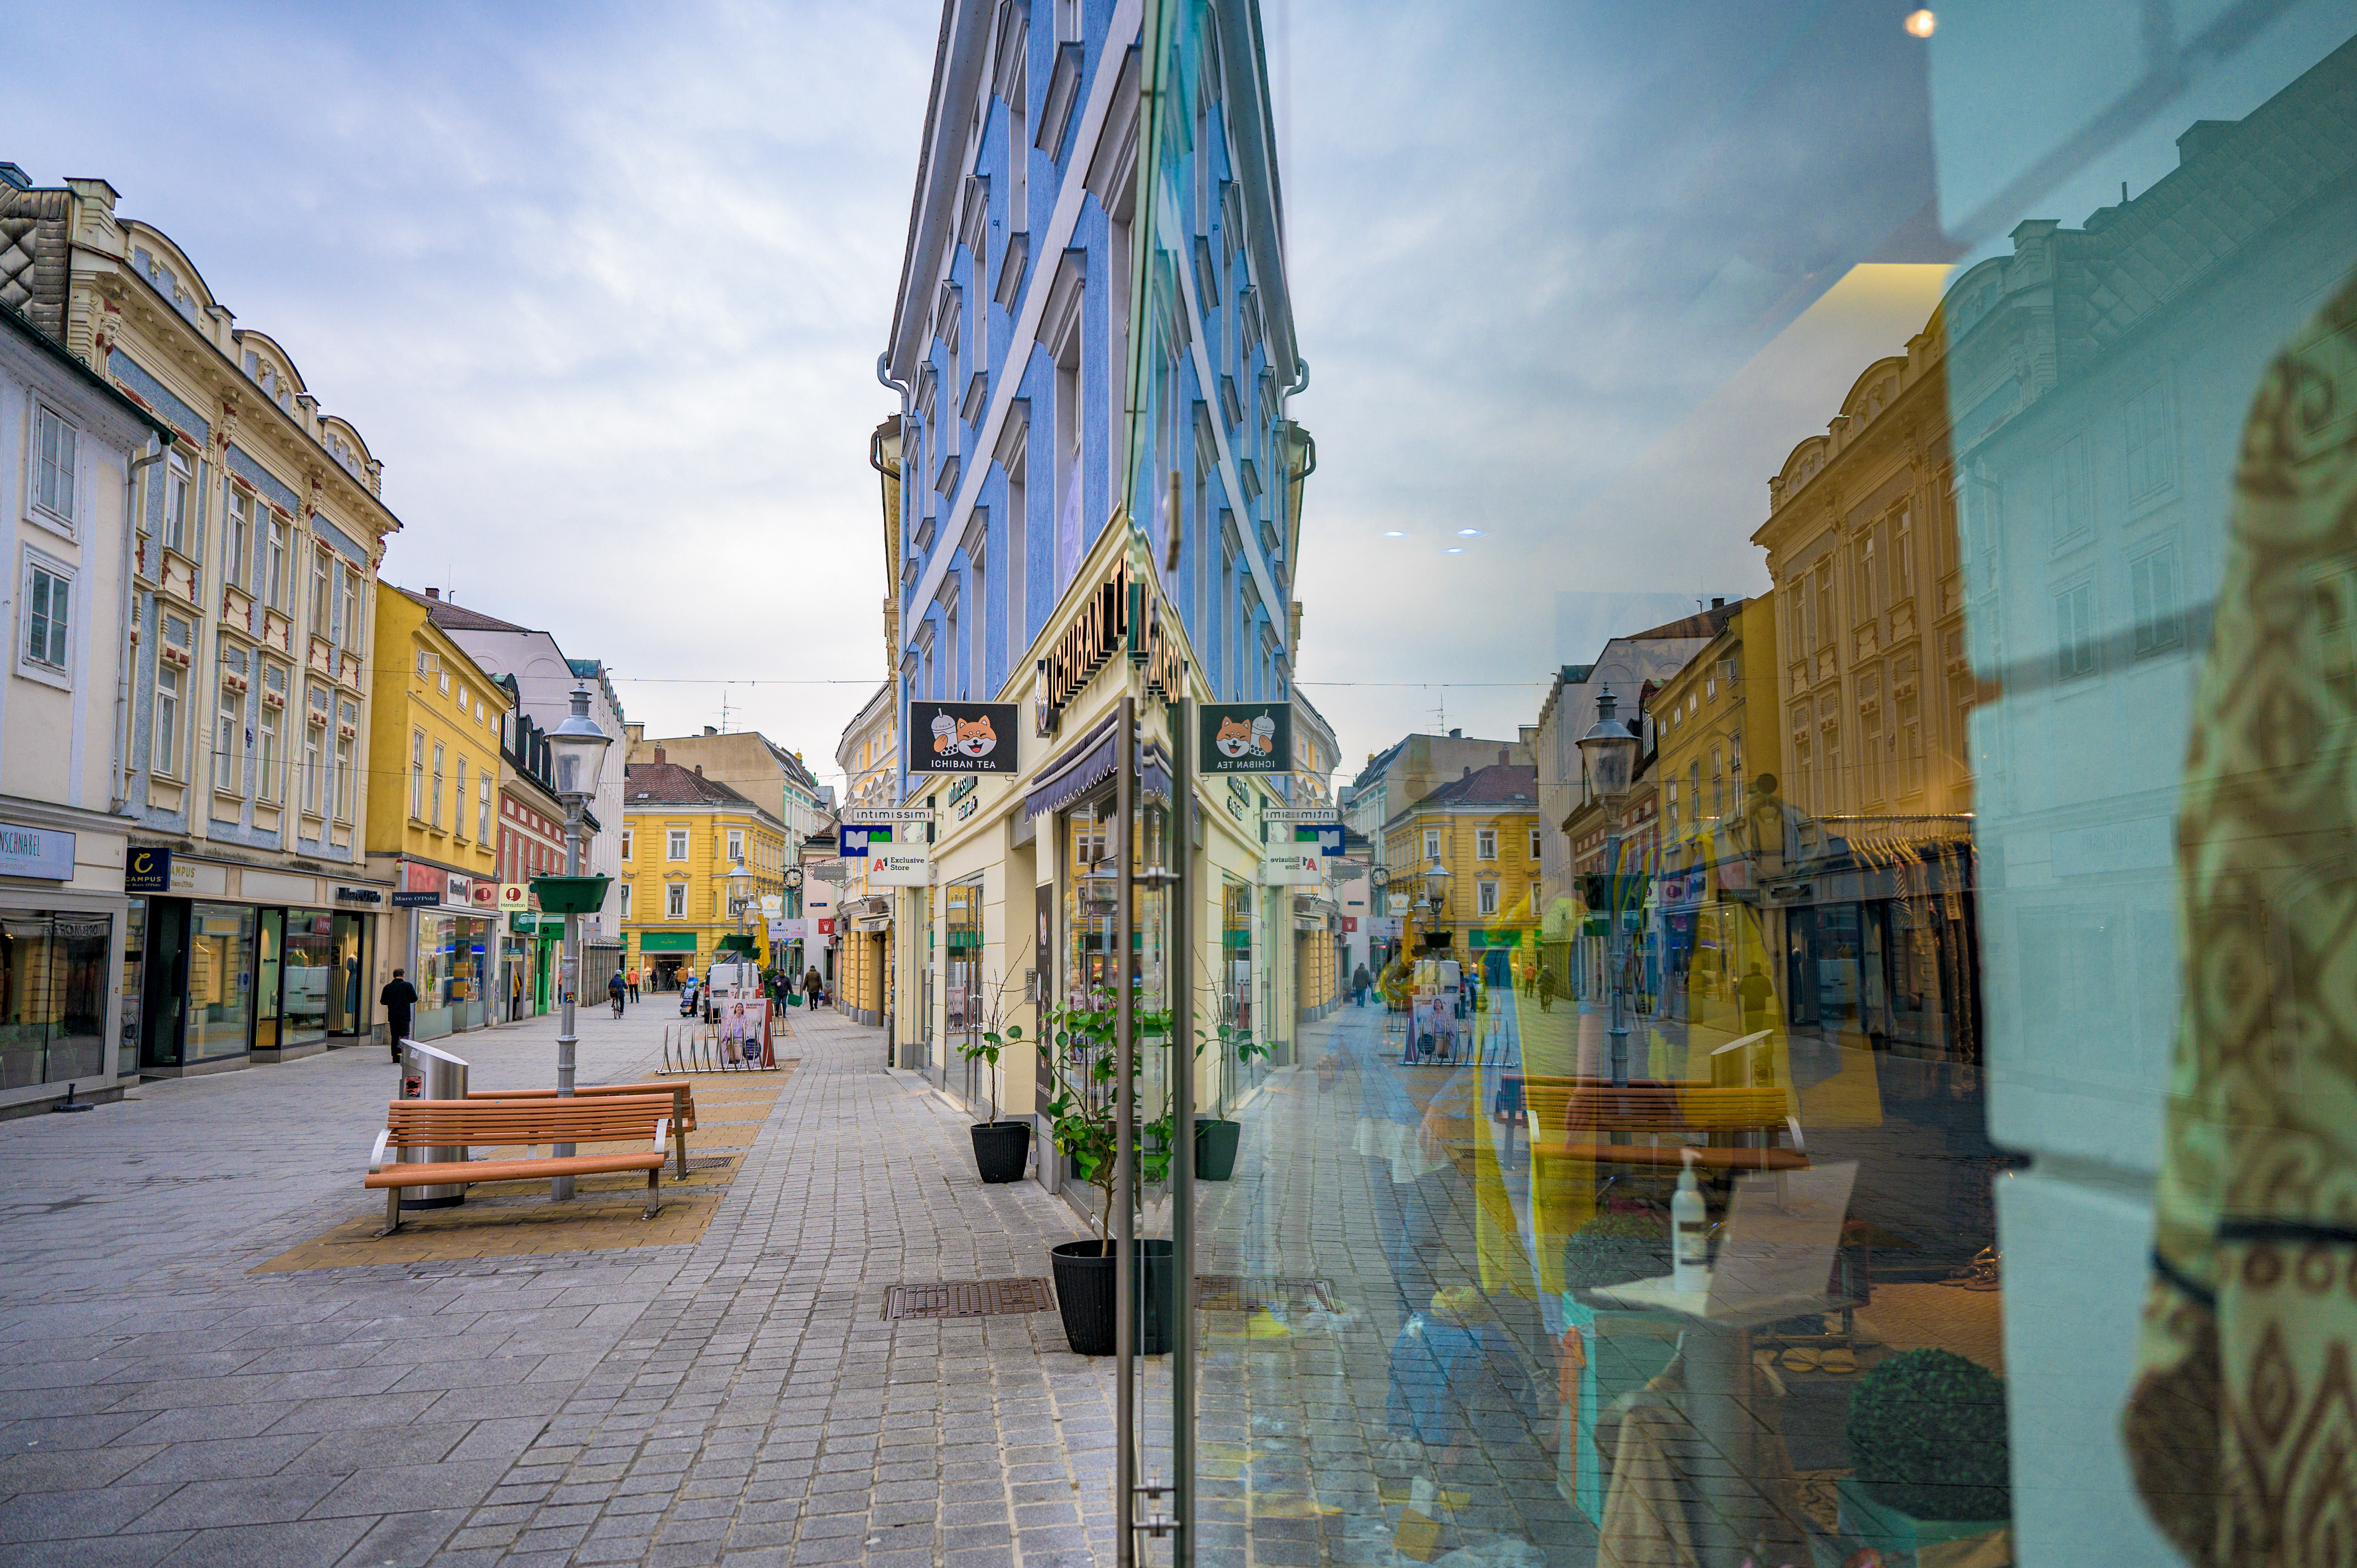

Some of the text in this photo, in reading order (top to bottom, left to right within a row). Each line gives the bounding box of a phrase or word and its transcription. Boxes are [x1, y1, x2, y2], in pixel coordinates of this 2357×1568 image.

[1050, 583, 1104, 710] ICHIBAN
[931, 760, 973, 768] ICHIBAN
[170, 865, 195, 878] AMPUS
